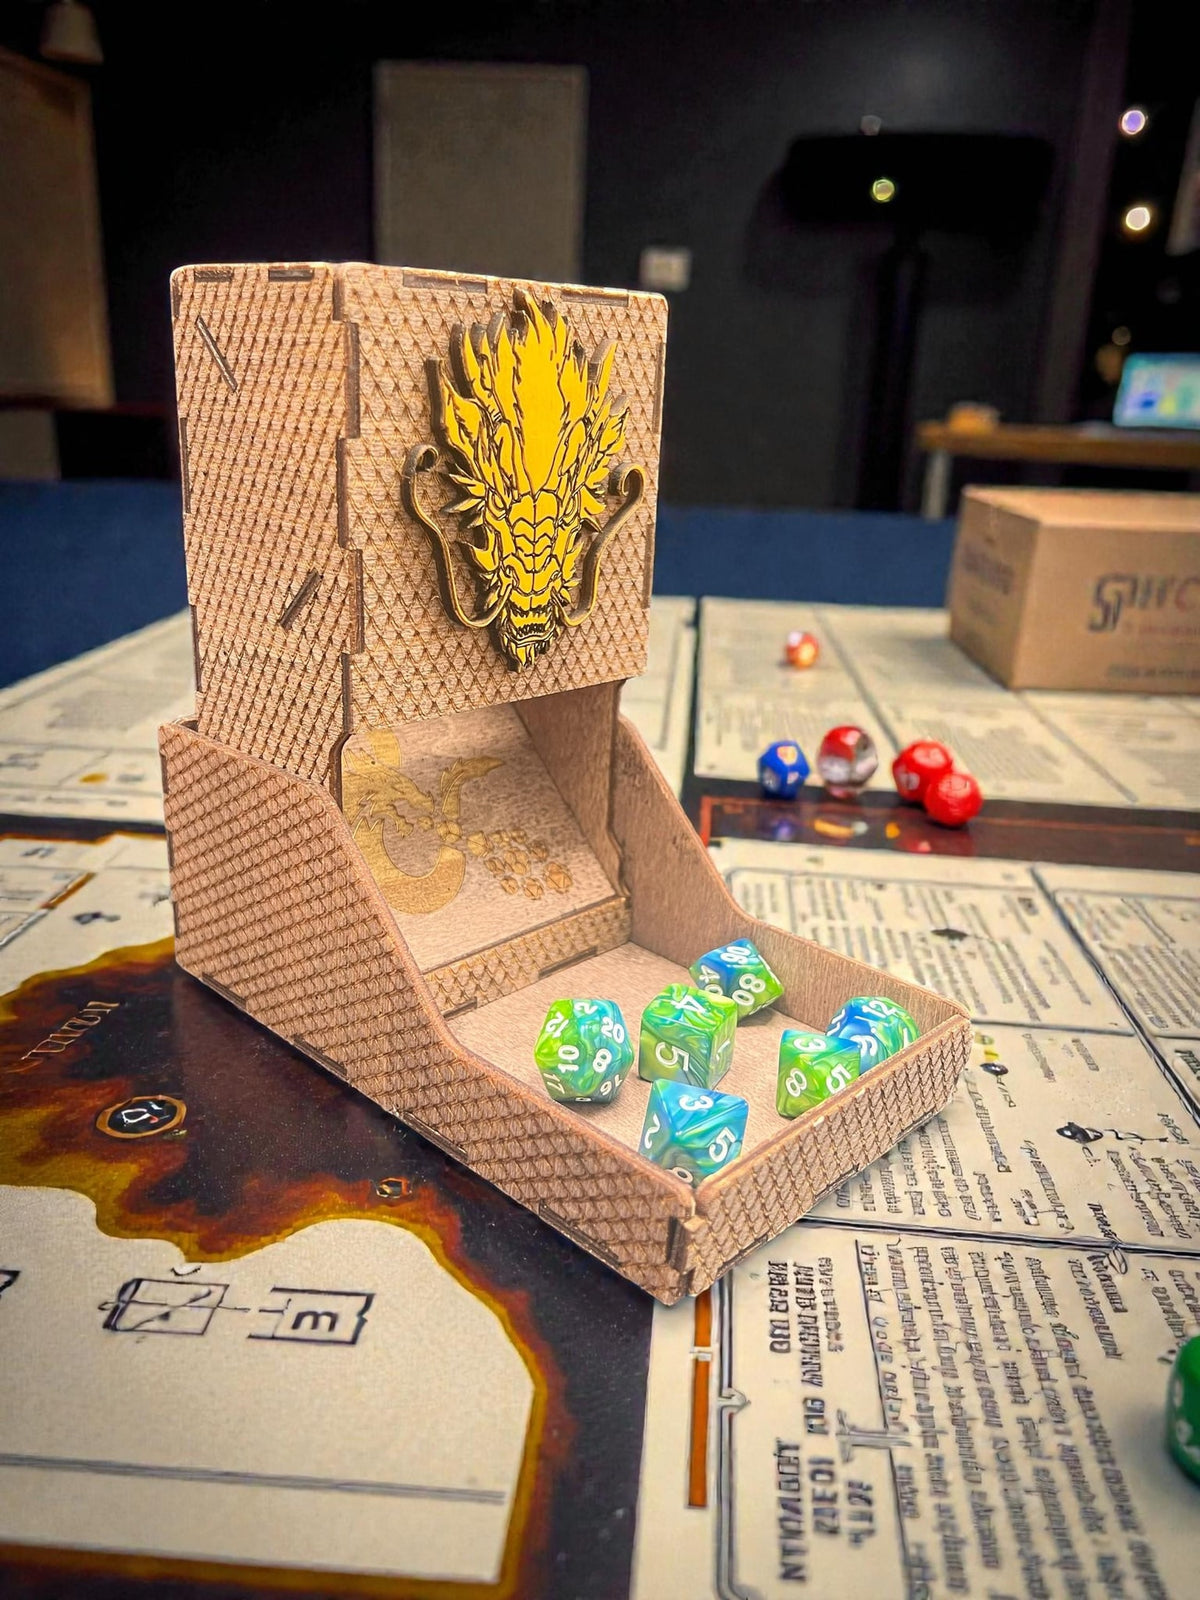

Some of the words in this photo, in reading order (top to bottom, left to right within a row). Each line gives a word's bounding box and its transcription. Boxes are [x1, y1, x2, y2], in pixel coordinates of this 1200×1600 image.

[731, 973, 766, 1006] 80
[670, 994, 707, 1014] 4
[861, 1000, 896, 1018] 12
[545, 1012, 569, 1037] 12
[601, 1016, 625, 1044] 20
[655, 1041, 690, 1072] 5
[793, 1038, 826, 1051] 3
[557, 1044, 580, 1074] 10
[592, 1047, 612, 1073] 8
[785, 1067, 807, 1097] 8
[825, 1062, 852, 1095] 5
[678, 1094, 714, 1111] 3
[708, 1126, 736, 1163] 5
